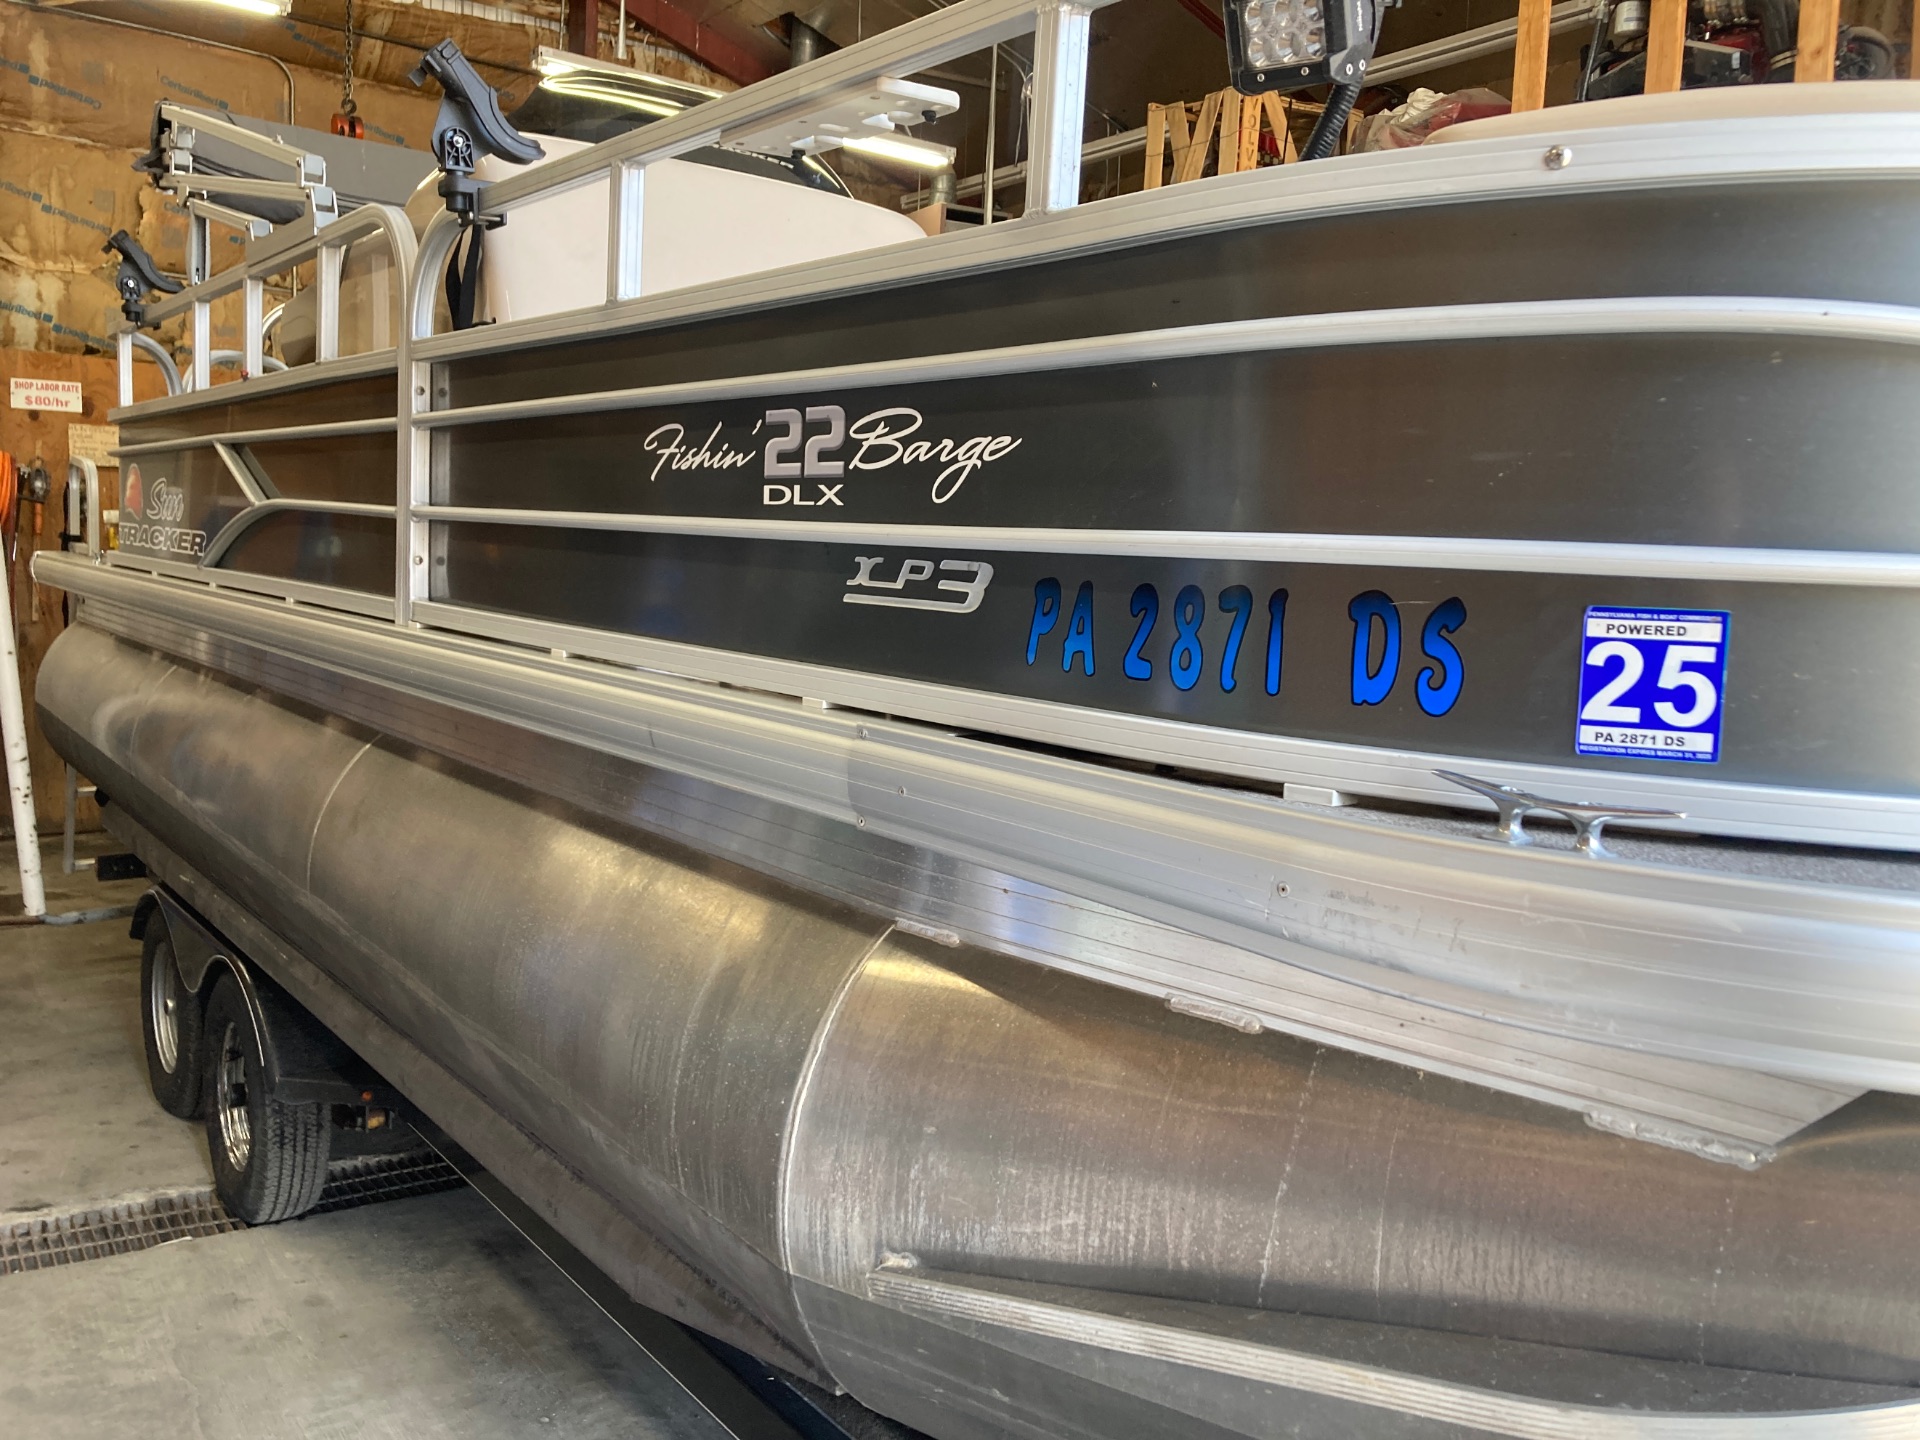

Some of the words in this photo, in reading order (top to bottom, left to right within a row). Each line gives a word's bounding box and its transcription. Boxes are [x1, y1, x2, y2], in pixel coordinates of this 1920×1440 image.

[14, 381, 34, 390] SHOP
[36, 382, 60, 392] LABOR
[61, 384, 79, 394] RATE
[643, 418, 763, 482] Fishin'
[763, 404, 846, 479] 22
[848, 407, 1022, 504] Barge
[146, 477, 185, 522] Sun
[763, 484, 844, 506] DLX
[119, 522, 207, 556] TRACKER
[843, 556, 994, 614] XP3
[1025, 576, 1096, 677] PA
[1123, 582, 1289, 697] 2871
[1348, 589, 1467, 718] DS
[1606, 623, 1687, 636] POWERED
[1580, 640, 1718, 728] 25
[1594, 731, 1614, 743] PA
[1619, 733, 1657, 745] 2871
[1664, 735, 1685, 747] DS
